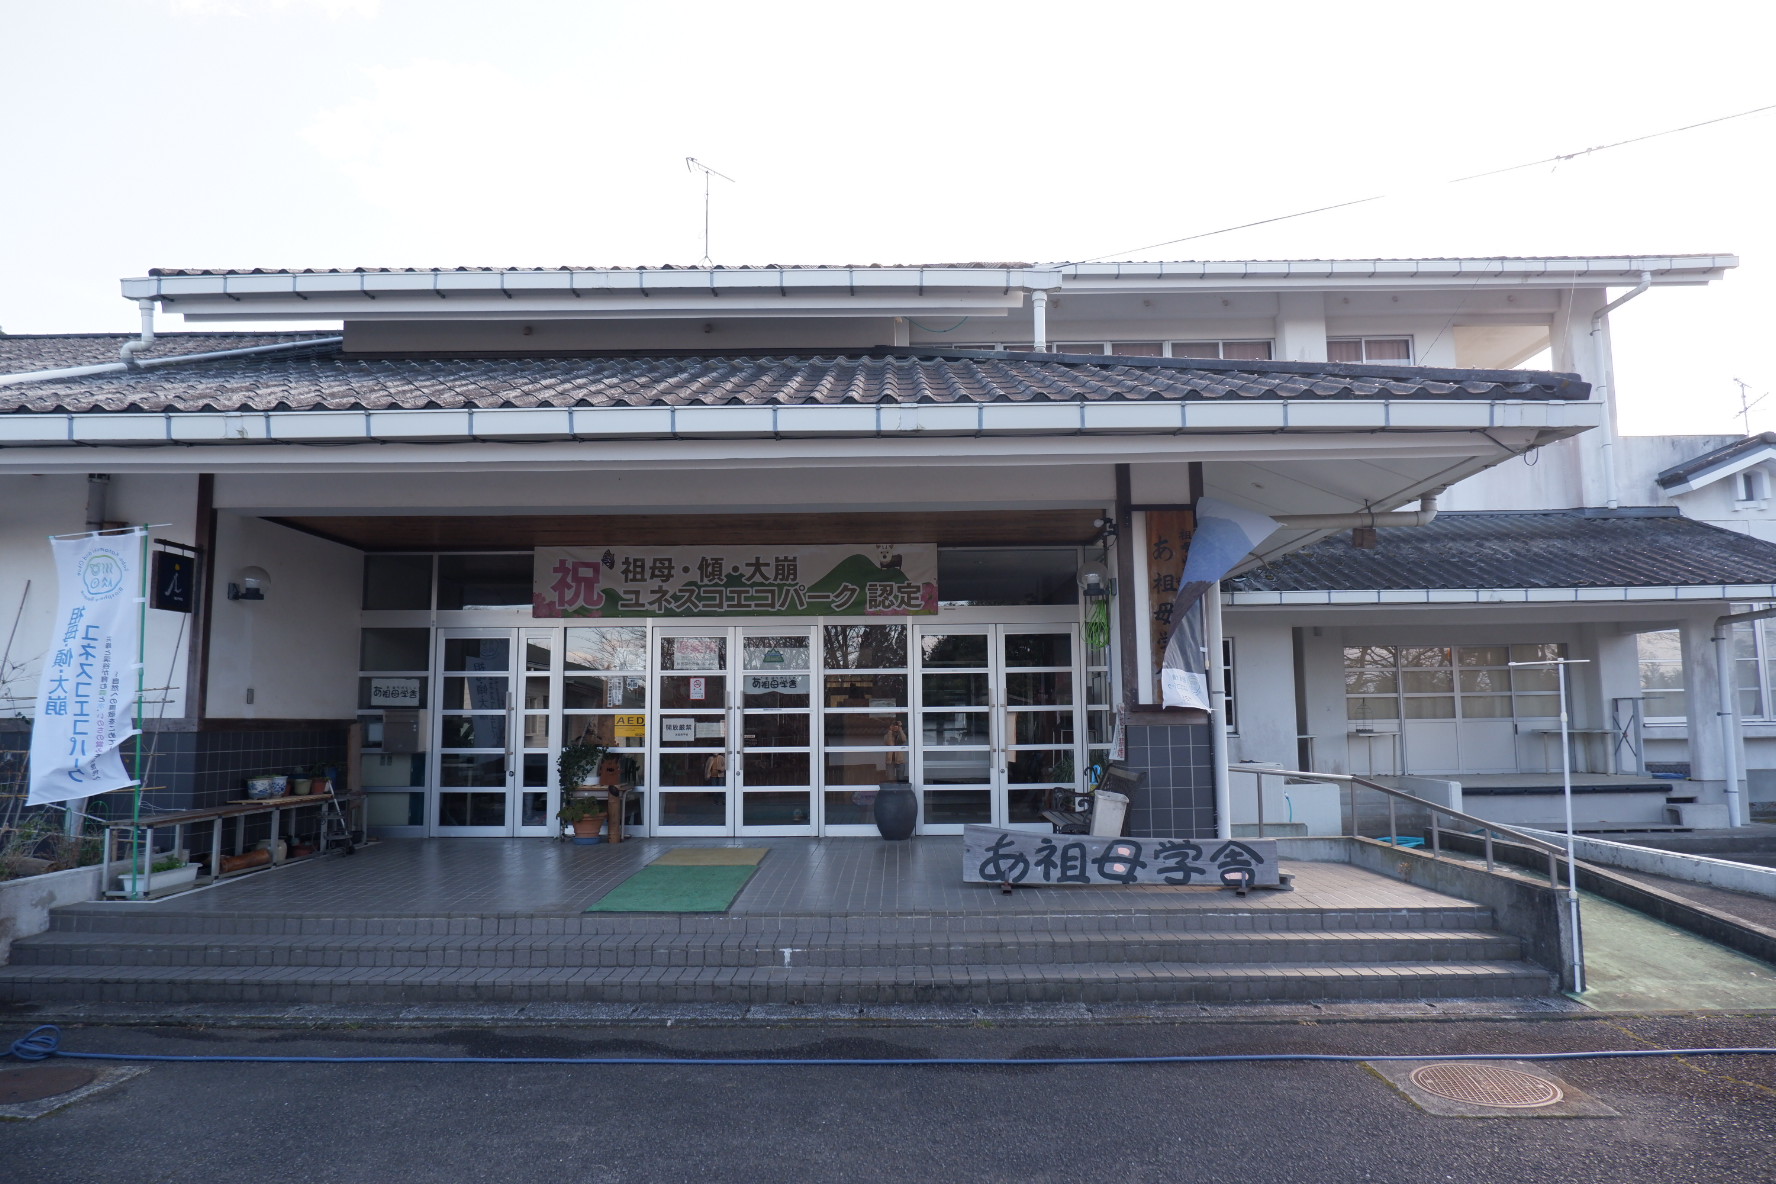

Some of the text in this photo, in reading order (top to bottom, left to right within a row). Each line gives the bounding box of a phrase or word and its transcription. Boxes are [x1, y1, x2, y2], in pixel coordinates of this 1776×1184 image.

[551, 557, 606, 610] 祝
[621, 556, 798, 583] 祖母・傾・大崩
[619, 583, 925, 611] ユネスコエコパーク 認定
[1152, 535, 1178, 676] あ祖母学
[752, 677, 798, 689] あ祖母学舎
[616, 717, 645, 725] AED
[978, 833, 1265, 887] あ祖母学舎
